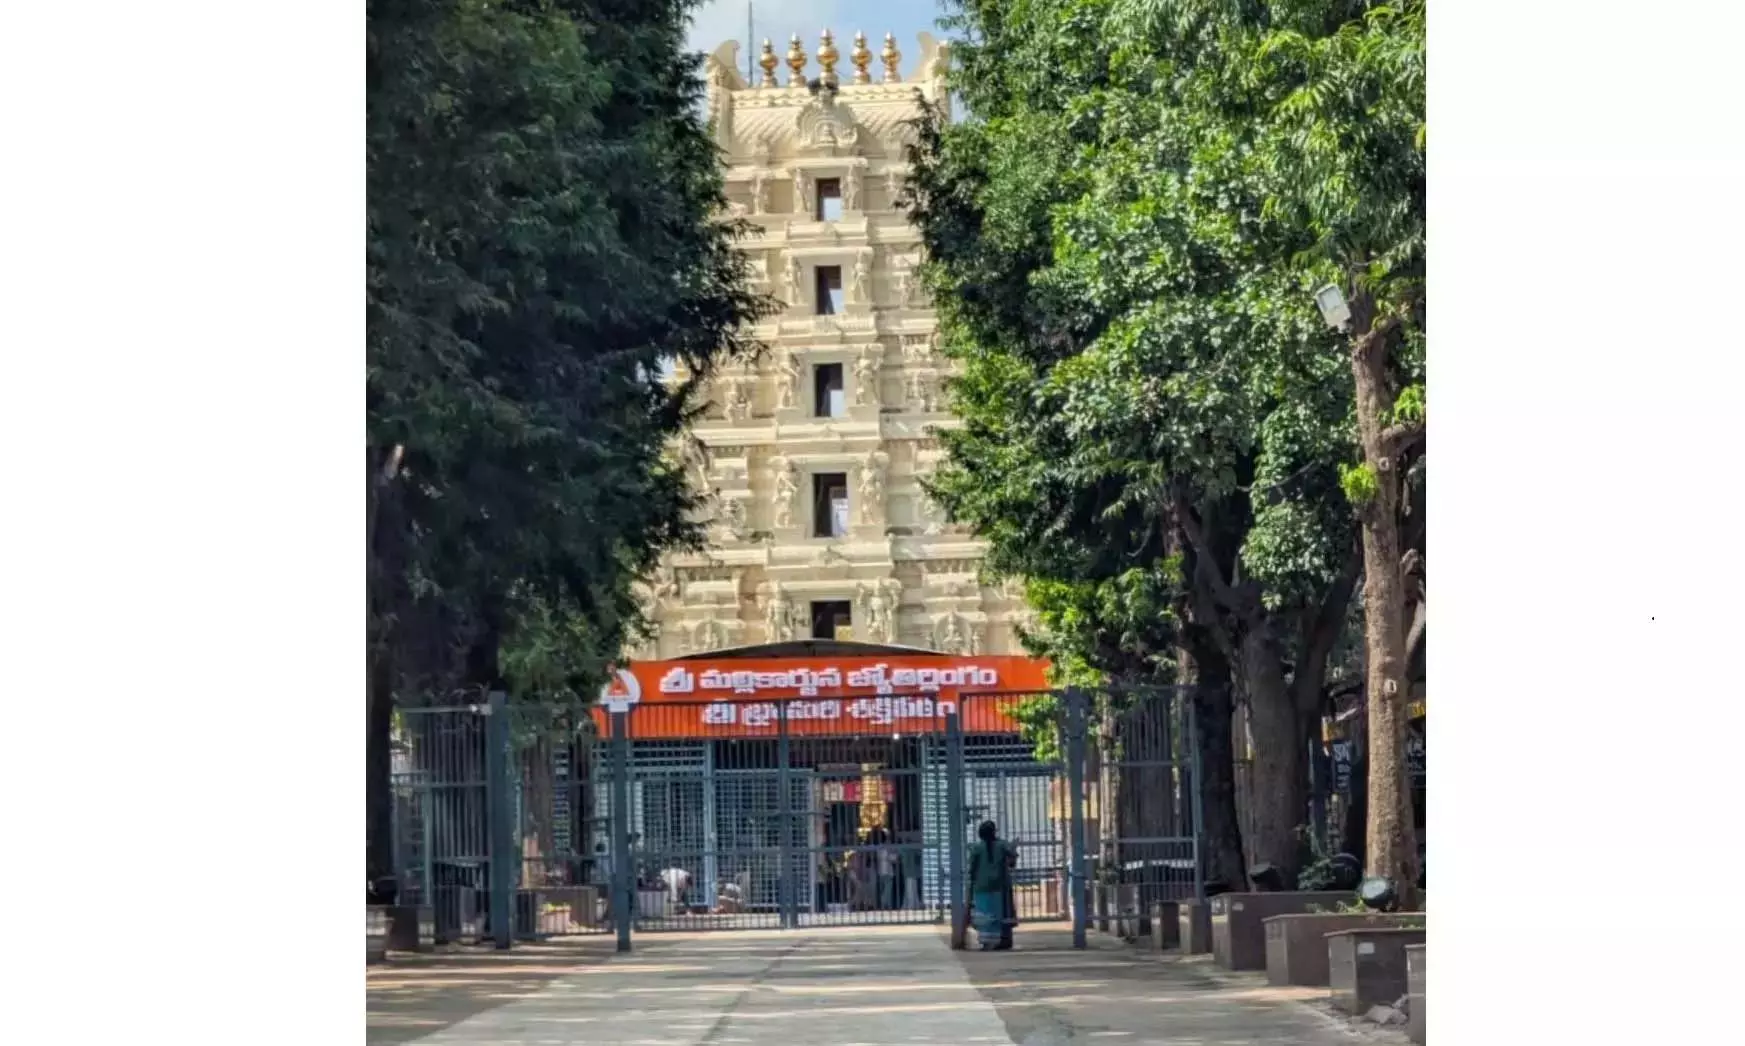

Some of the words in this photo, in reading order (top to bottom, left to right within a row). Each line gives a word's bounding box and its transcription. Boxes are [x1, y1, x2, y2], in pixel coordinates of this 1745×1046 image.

[659, 667, 694, 693] శ్రీ
[700, 668, 842, 696] మల్లికార్జున
[847, 663, 997, 694] జ్యోతిర్లింగం
[702, 698, 737, 724] శ్రీ
